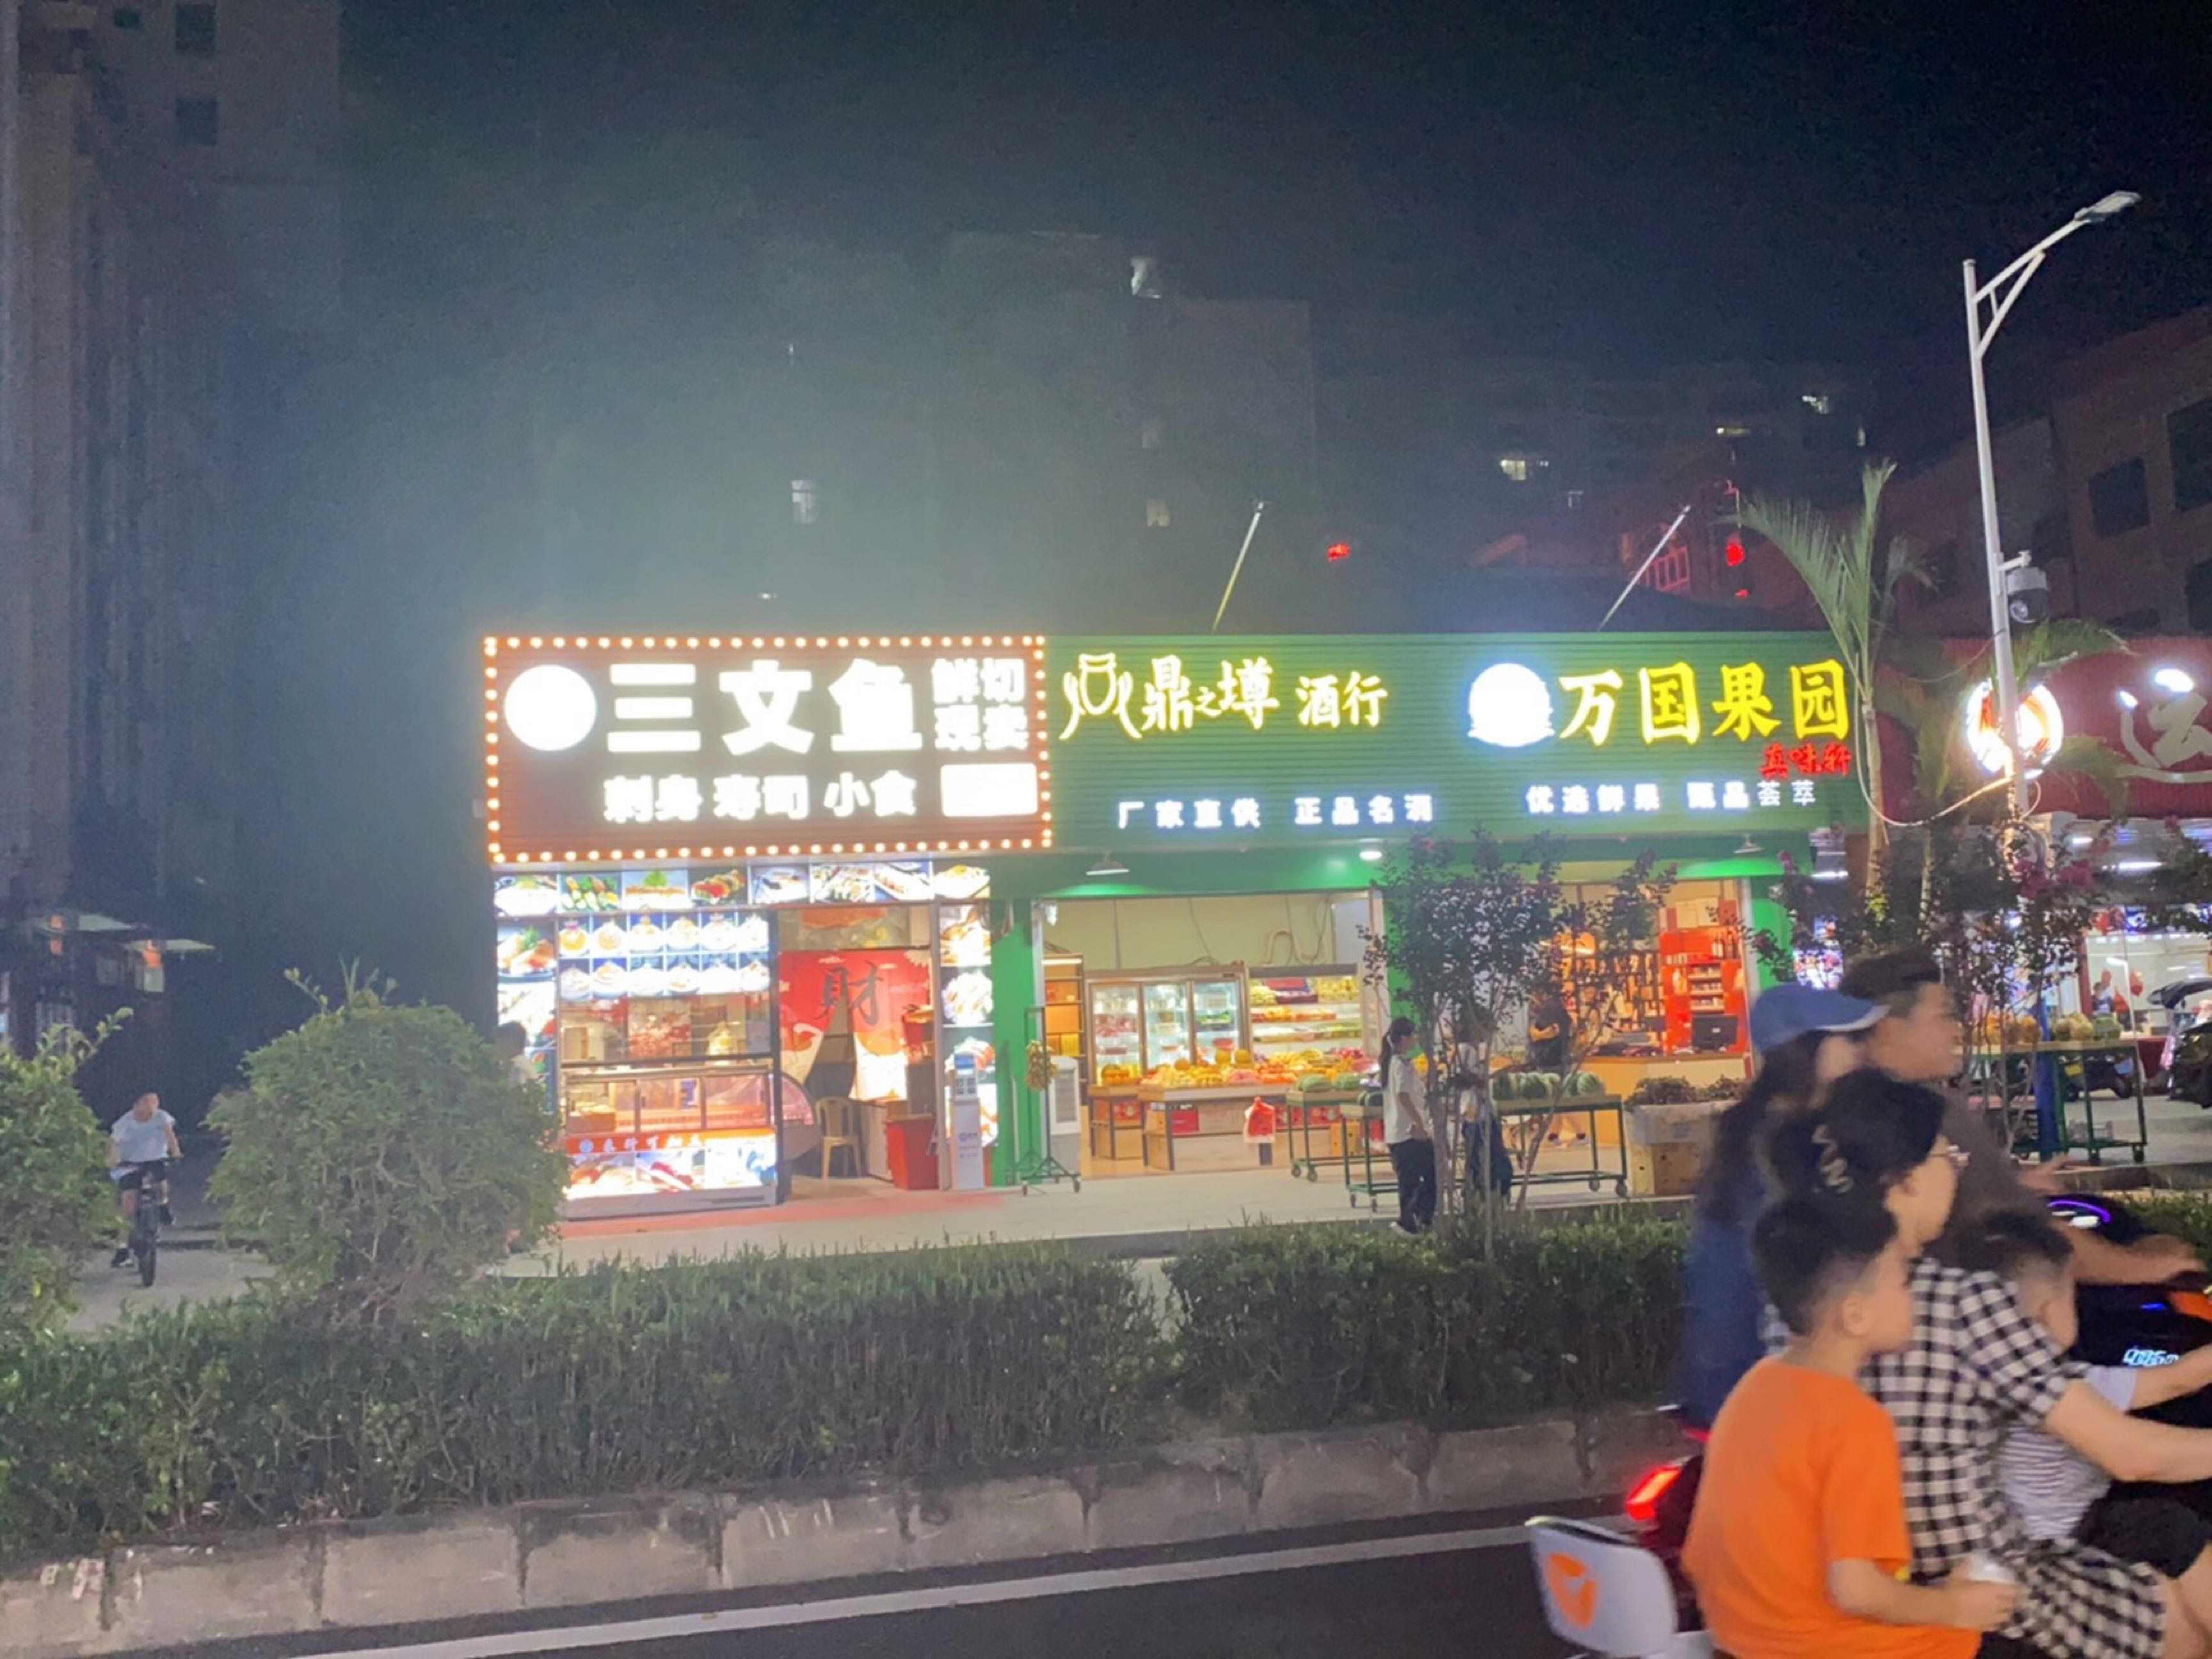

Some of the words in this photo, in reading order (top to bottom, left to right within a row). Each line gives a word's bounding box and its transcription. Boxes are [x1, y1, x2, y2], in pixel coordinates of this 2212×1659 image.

[608, 659, 923, 755] 三文鱼
[1295, 671, 1388, 728] 酒行
[1559, 659, 1850, 746] 万国果园
[603, 773, 703, 822] 刺身
[712, 773, 809, 821] 寿司
[822, 769, 917, 817] 小食
[1118, 797, 1261, 829] 厂家直供
[1295, 794, 1432, 825] 正品名酒
